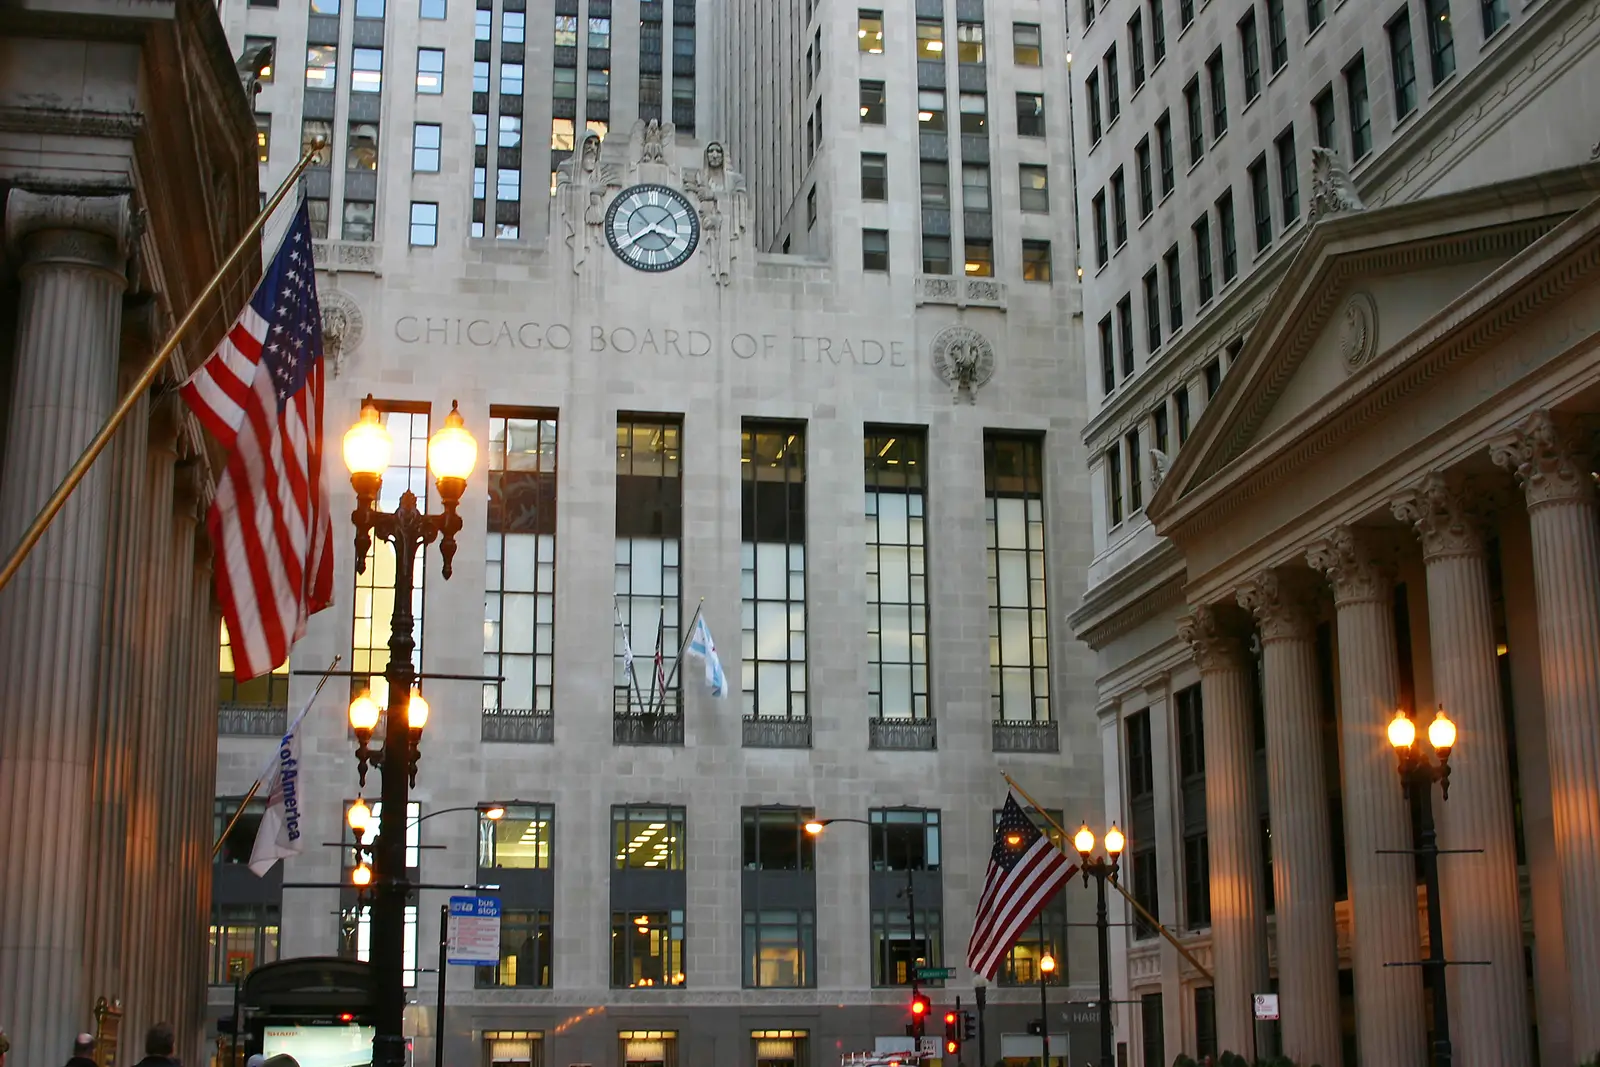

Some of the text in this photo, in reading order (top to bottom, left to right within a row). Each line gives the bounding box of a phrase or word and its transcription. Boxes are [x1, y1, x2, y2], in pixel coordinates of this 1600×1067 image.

[394, 315, 906, 369] CHICAGO BOARD OF TRADE
[281, 769, 301, 842] America
[477, 907, 498, 916] stop
[478, 899, 494, 907] bus
